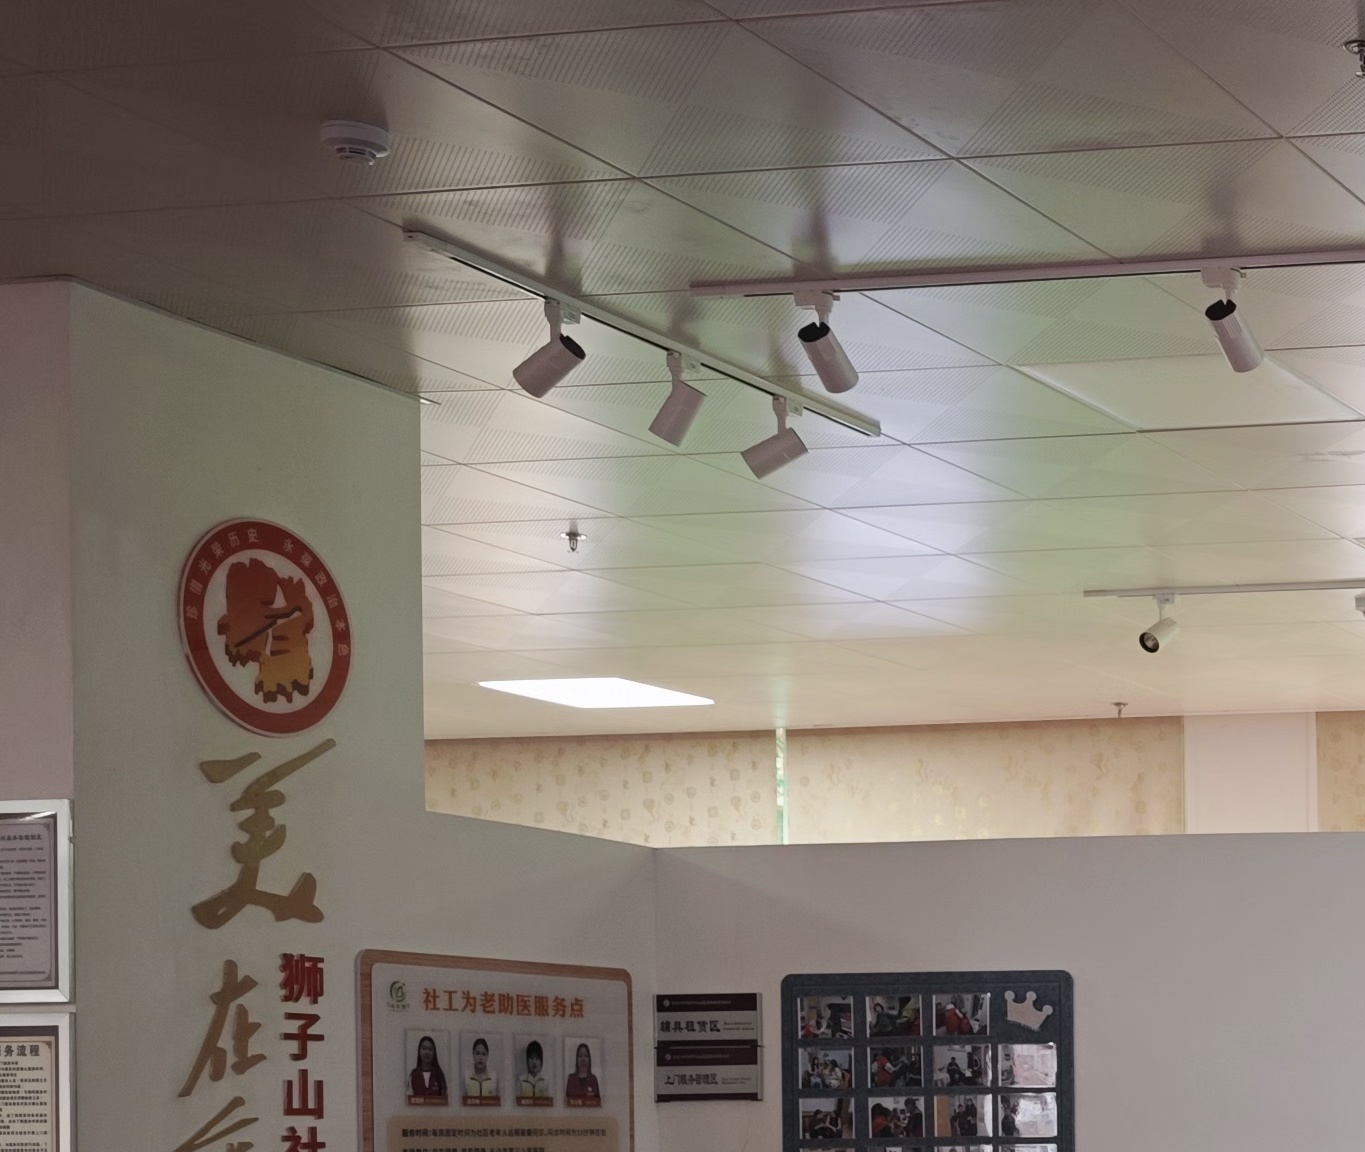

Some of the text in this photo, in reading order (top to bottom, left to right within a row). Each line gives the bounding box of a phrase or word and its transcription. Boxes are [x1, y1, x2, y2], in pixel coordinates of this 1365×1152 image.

[422, 987, 585, 1019] 社工为老助医服务点
[0, 1044, 41, 1058] 务流程
